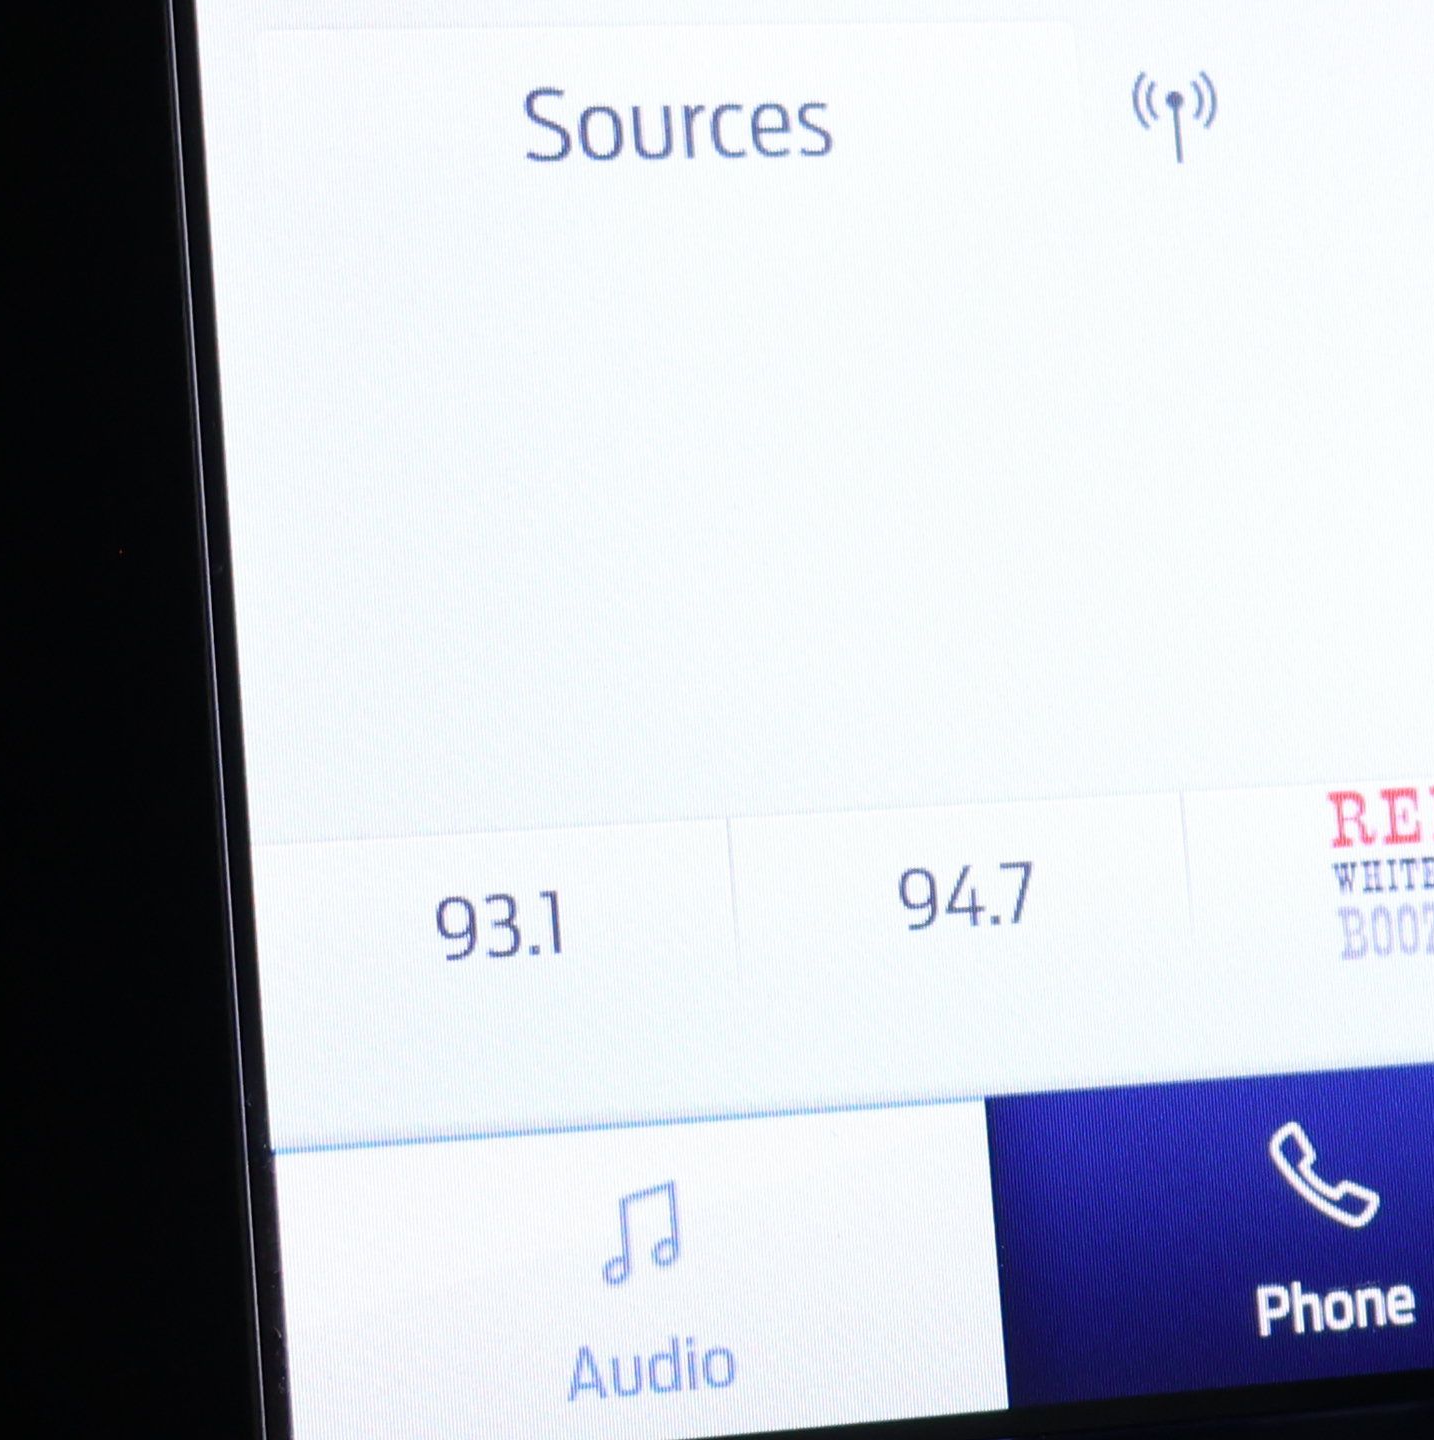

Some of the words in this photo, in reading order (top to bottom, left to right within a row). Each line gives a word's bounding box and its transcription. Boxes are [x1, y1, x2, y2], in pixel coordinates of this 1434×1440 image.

[524, 87, 832, 162] Sources
[436, 891, 561, 961] 93.1
[899, 862, 1032, 931] 94.7
[1257, 1281, 1415, 1336] Phone
[568, 1337, 735, 1402] Audio
